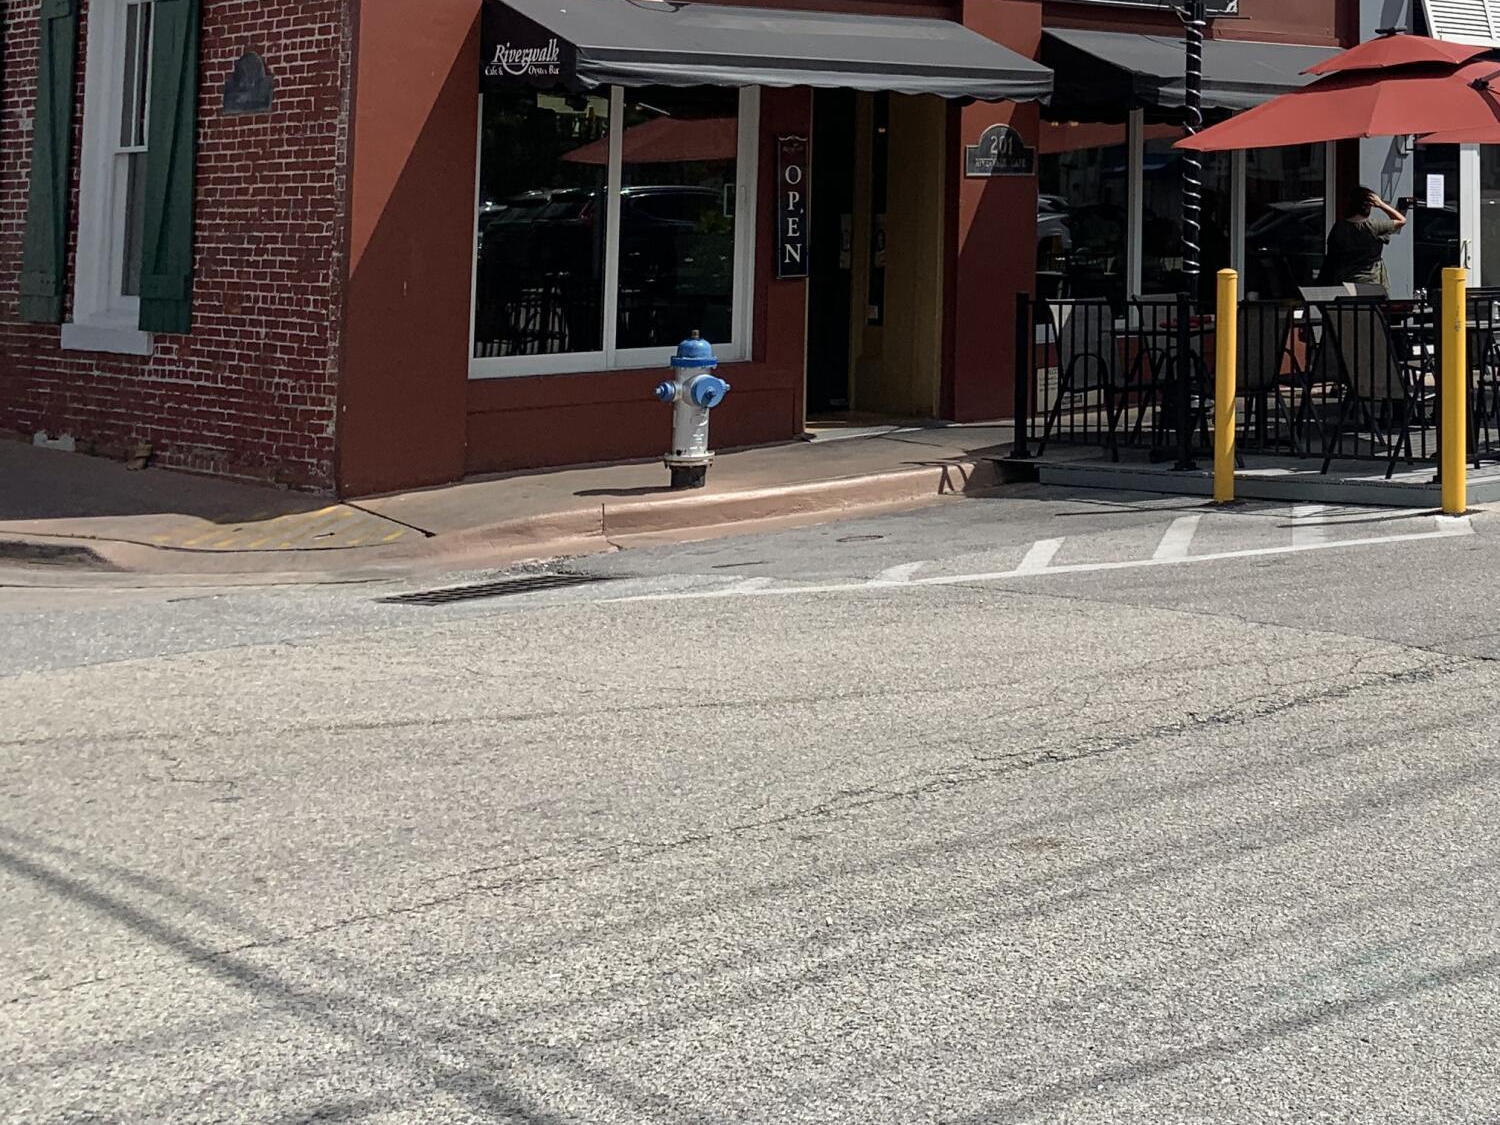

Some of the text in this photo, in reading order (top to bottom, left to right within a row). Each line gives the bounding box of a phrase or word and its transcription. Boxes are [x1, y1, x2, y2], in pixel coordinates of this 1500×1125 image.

[491, 38, 560, 75] Riverwalk
[990, 135, 1013, 155] 201
[784, 164, 802, 263] OPEN
